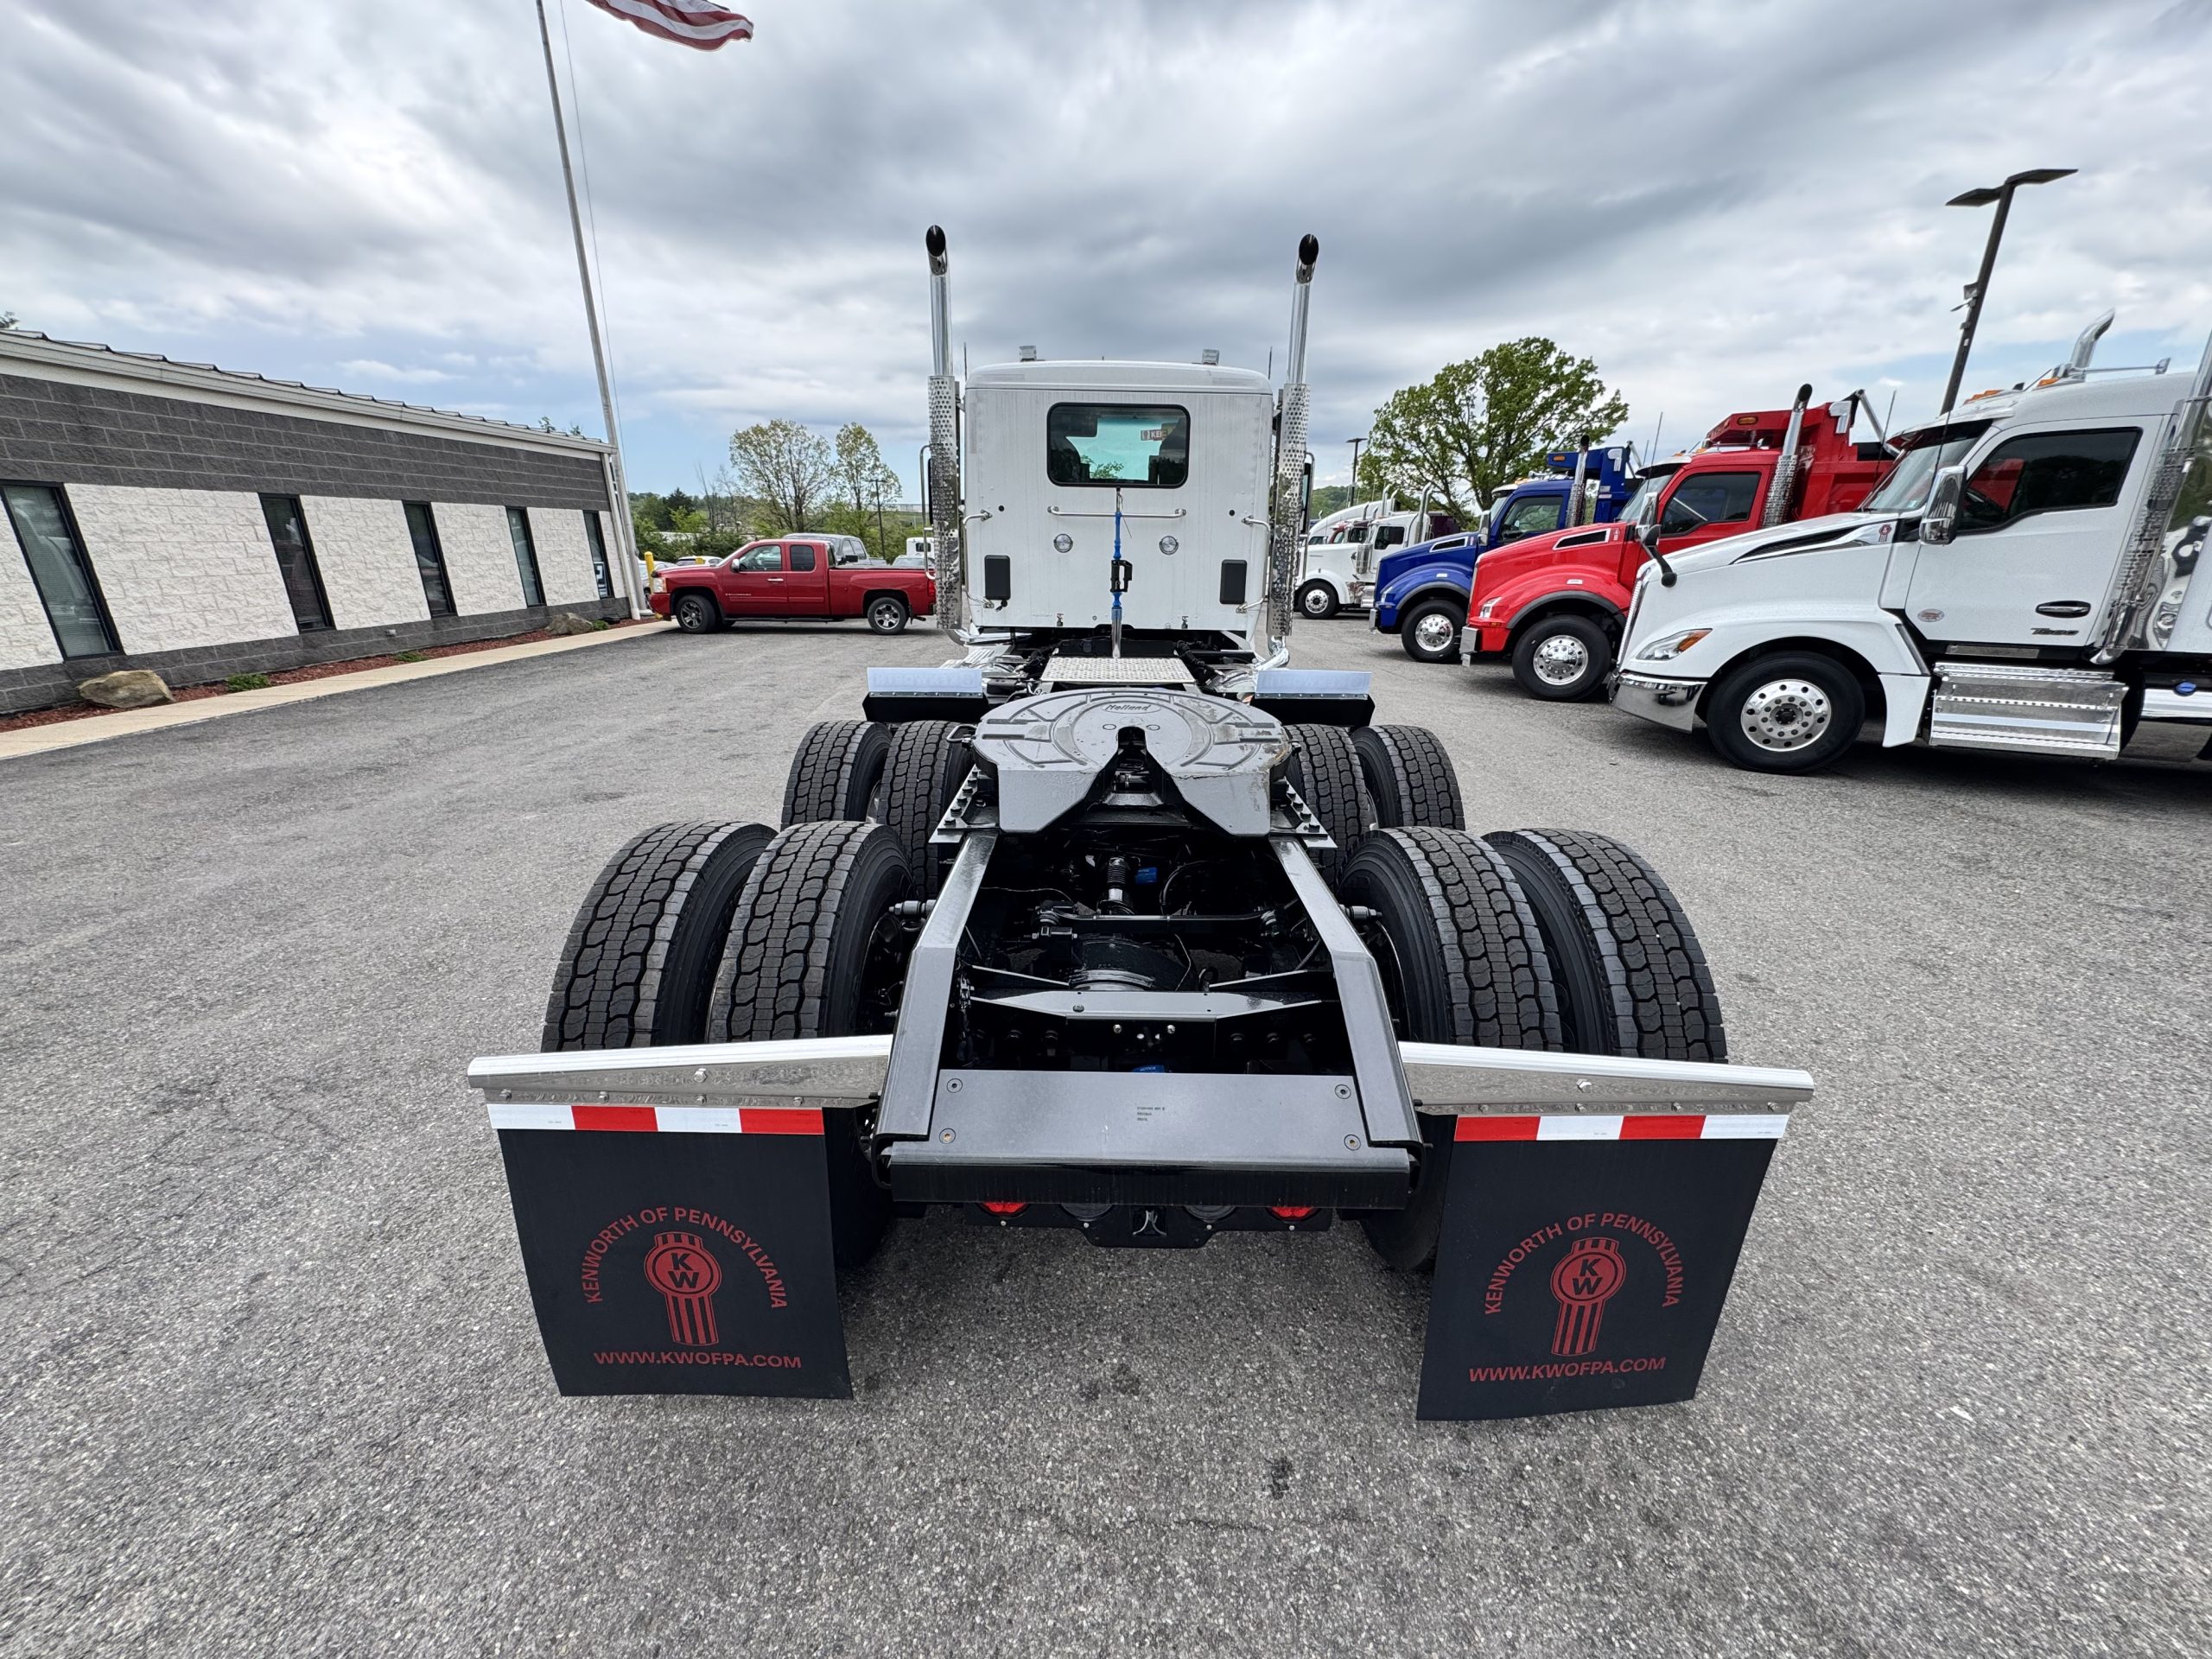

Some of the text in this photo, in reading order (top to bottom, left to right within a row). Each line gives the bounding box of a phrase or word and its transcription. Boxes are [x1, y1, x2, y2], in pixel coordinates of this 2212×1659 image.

[582, 1206, 788, 1309] KENWORTH OF PENNSYLVANIA
[1484, 1211, 1684, 1315] KENWORTH OF PENNSYLVANIA
[594, 1351, 803, 1369] WWW.KWOFPA.COM
[1468, 1357, 1667, 1382] WWW.KWOFPA.COM
